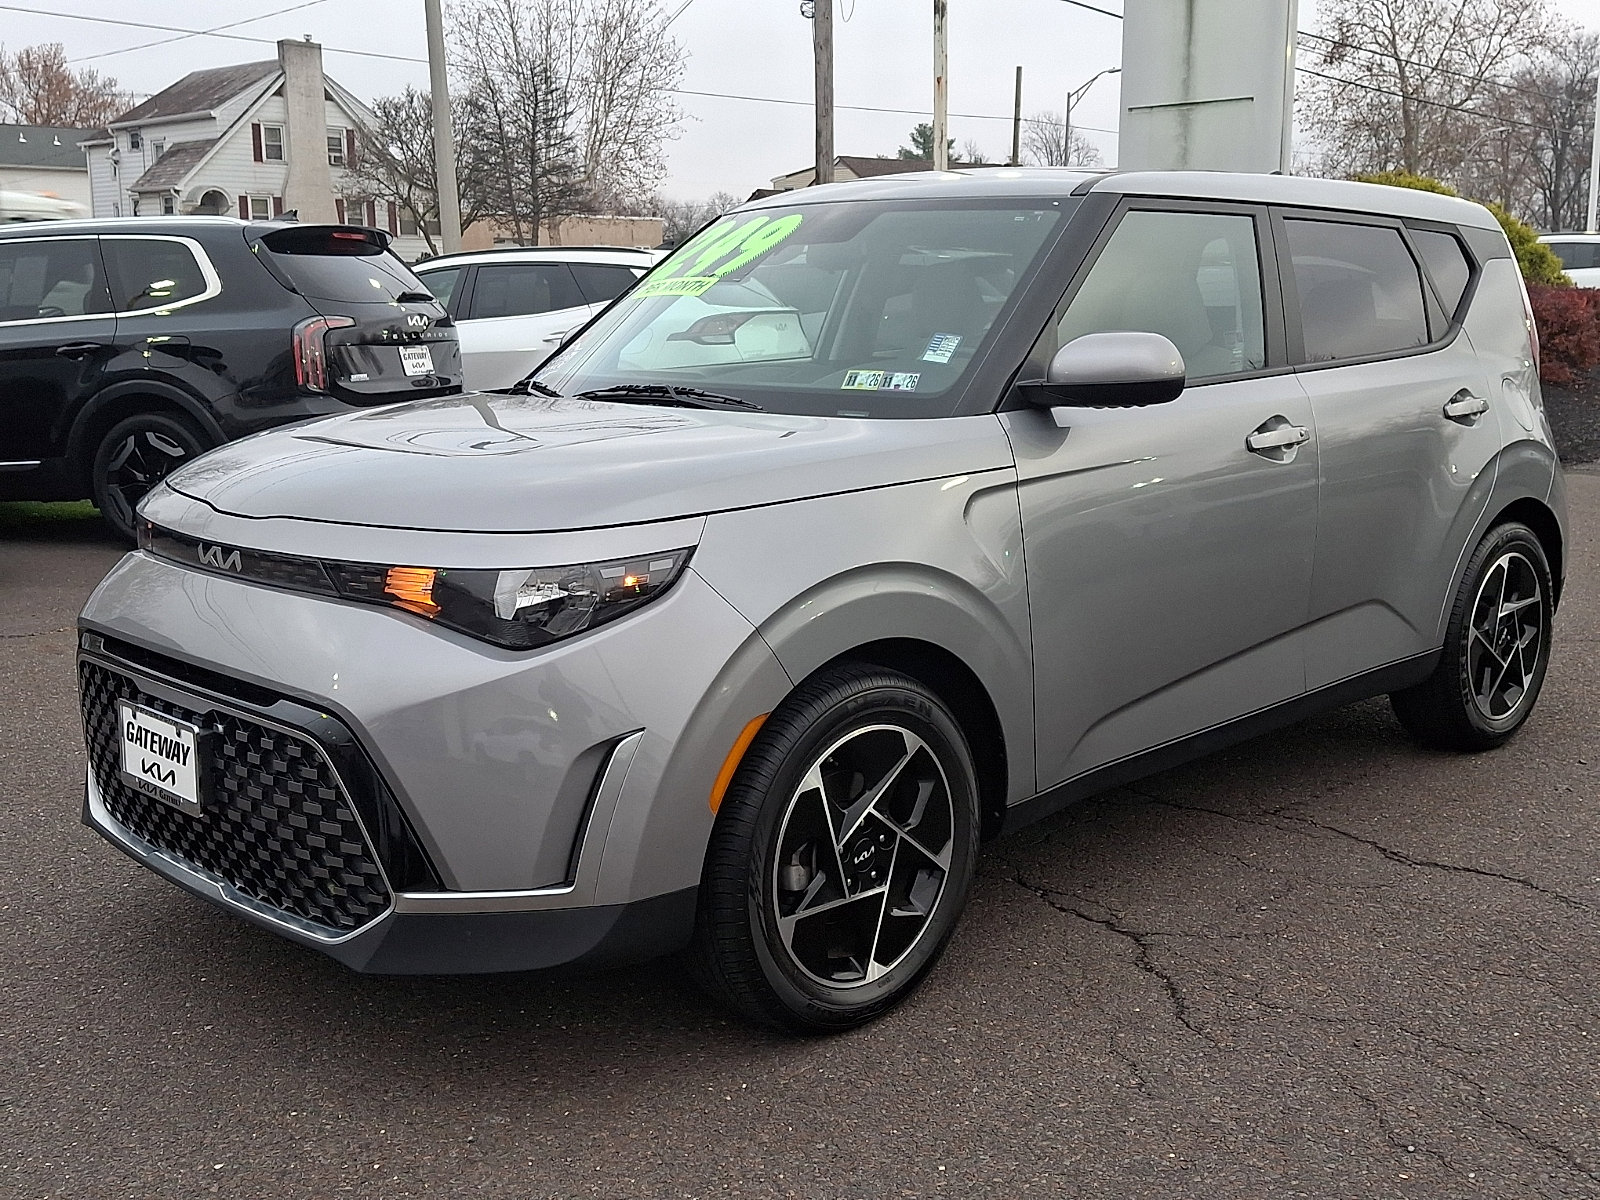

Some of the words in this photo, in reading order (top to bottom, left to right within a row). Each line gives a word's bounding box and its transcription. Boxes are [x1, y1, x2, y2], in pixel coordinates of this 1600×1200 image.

[407, 315, 428, 326] KIA
[403, 352, 427, 361] GATEWAY
[198, 542, 242, 572] KIA
[126, 721, 191, 767] GATEWAY
[141, 758, 176, 787] KIA
[139, 780, 158, 796] KIA
[854, 845, 875, 865] KIA
